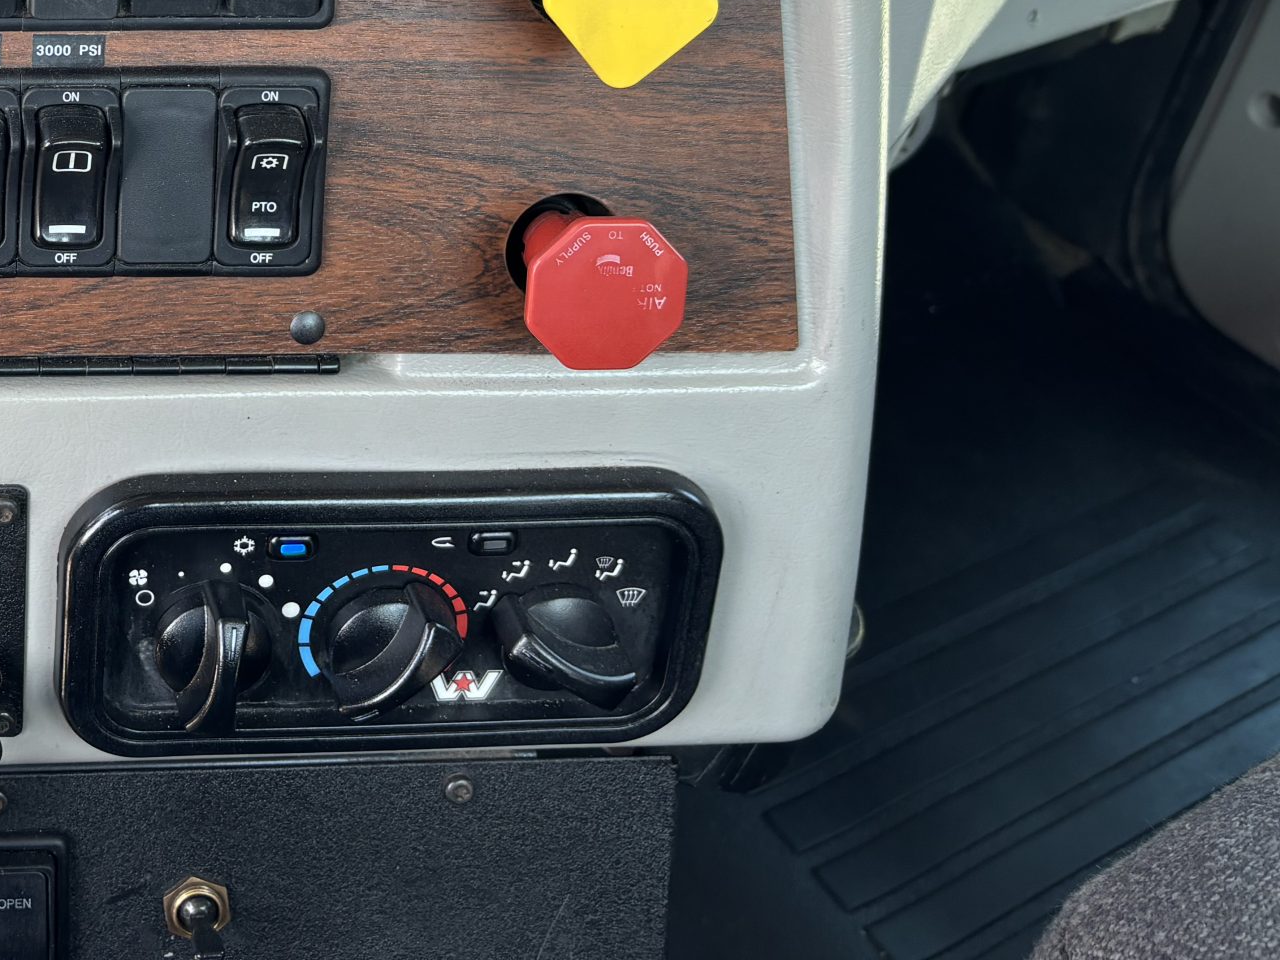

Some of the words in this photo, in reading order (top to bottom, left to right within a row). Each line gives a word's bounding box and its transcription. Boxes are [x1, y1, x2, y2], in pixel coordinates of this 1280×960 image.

[36, 44, 71, 57] 3000
[79, 44, 102, 57] PSI
[62, 91, 80, 102] ON
[261, 91, 279, 102] ON
[251, 202, 277, 213] PTO
[608, 230, 624, 240] TO
[555, 231, 592, 267] SUPPLY
[639, 231, 665, 257] PUSH
[54, 253, 77, 264] OFF
[250, 253, 273, 264] OFF
